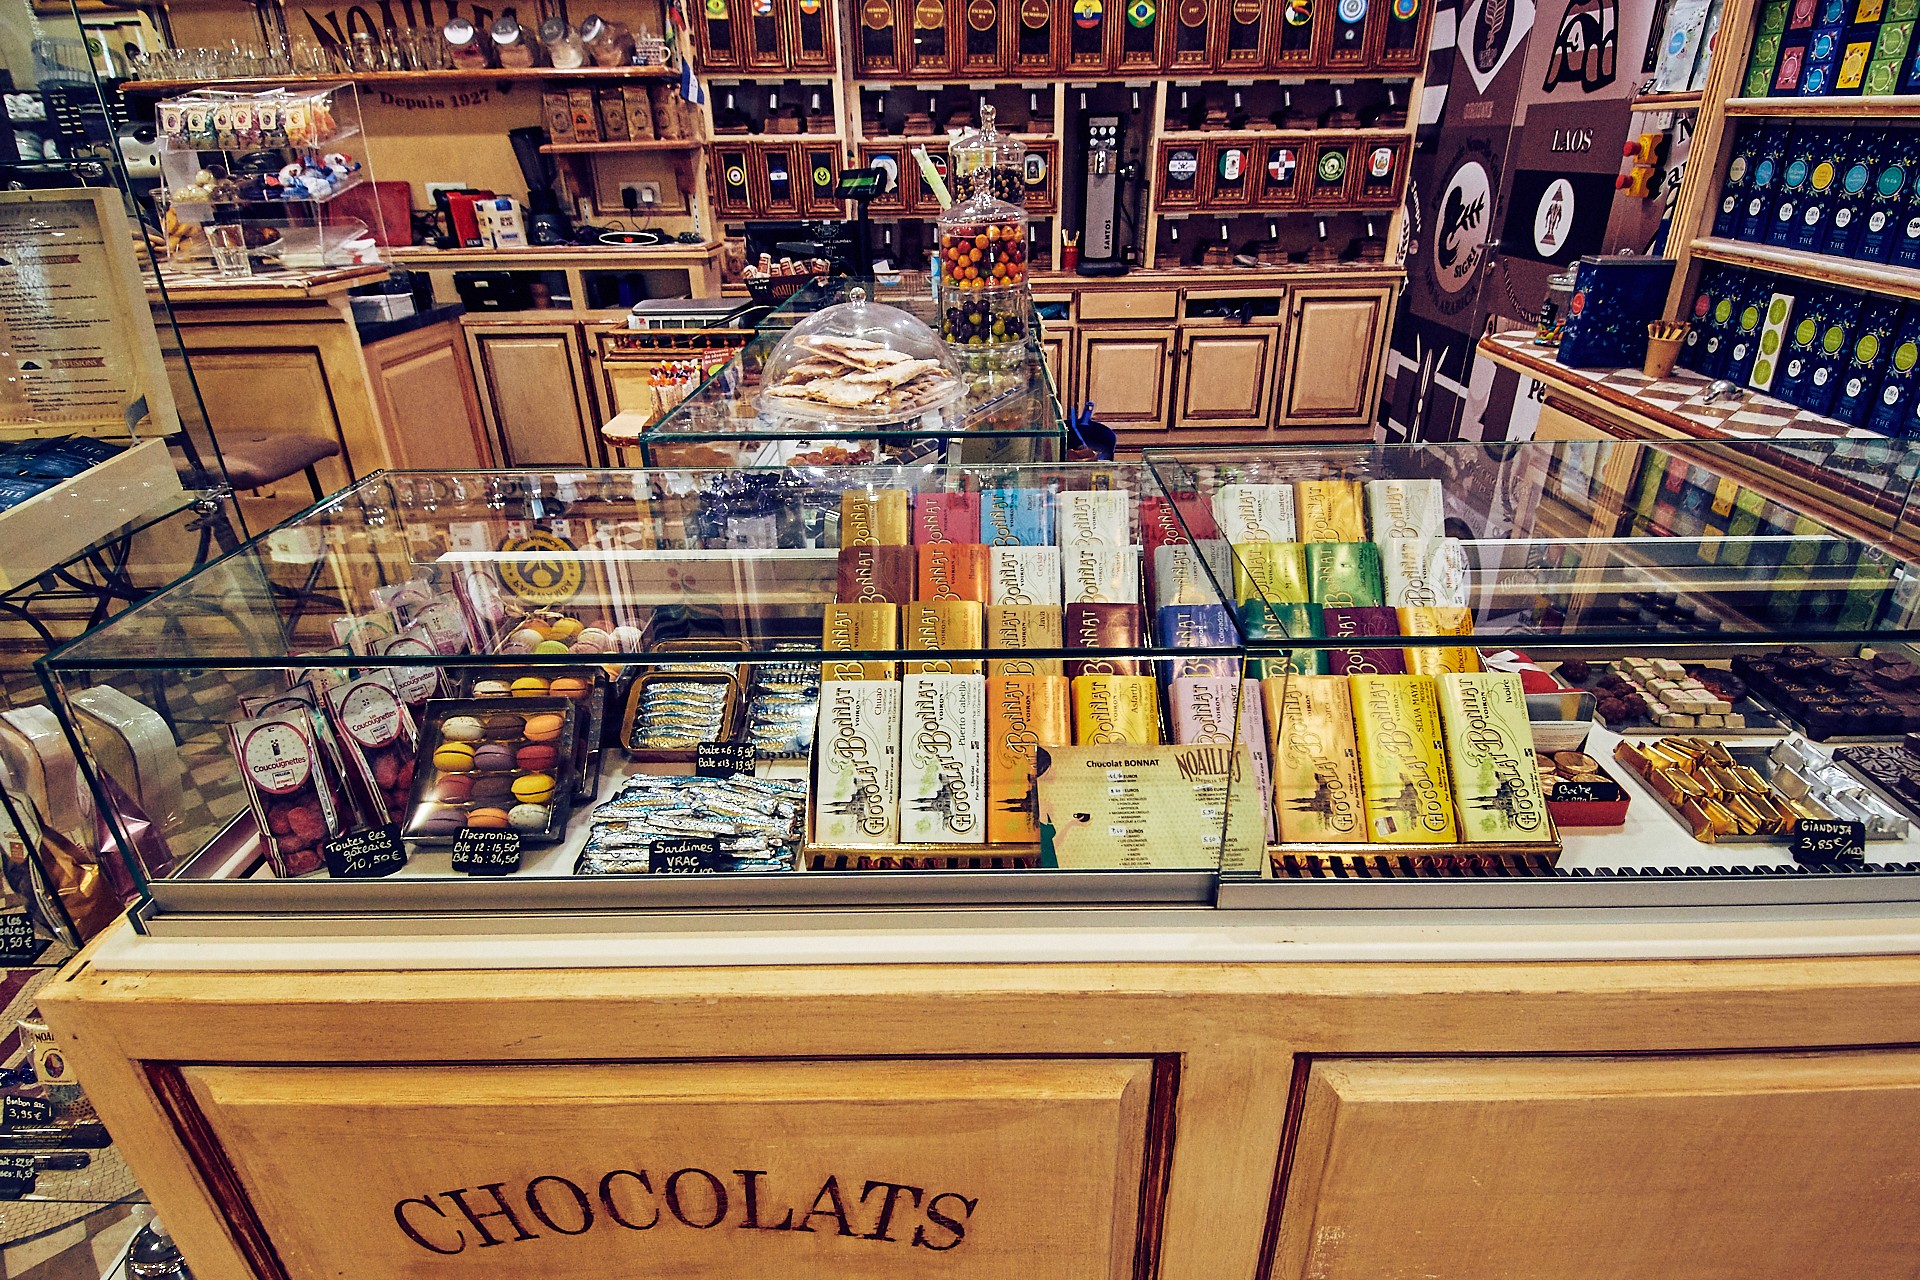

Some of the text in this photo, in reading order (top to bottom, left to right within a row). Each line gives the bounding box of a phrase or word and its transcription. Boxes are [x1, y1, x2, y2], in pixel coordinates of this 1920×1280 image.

[379, 89, 490, 110] Depuis 1927
[1550, 128, 1594, 153] LAOS
[1103, 219, 1112, 250] SANTOS
[1744, 227, 1755, 236] THÉ
[1773, 232, 1787, 241] THÉ
[1799, 236, 1813, 245] THÉ
[1830, 241, 1844, 250] THÉ
[1864, 246, 1879, 255] THÉ
[1900, 251, 1916, 260] THÉ
[57, 359, 98, 368] INFUSIONS
[0, 488, 26, 499] HÉ
[851, 496, 880, 546] BONNAT
[924, 498, 952, 546] BONNAT
[990, 494, 1021, 547] BONNAT
[1073, 496, 1104, 546] BONNAT
[1239, 488, 1271, 543] BONNAT
[1307, 486, 1340, 543] BONNAT
[1385, 485, 1419, 539] BONNAT
[855, 551, 887, 604] BONNAT
[929, 550, 961, 602] BONNAT
[999, 552, 1032, 605] BONNAT
[1078, 550, 1108, 604] BONNAT
[1400, 543, 1436, 608] BONNAT
[1038, 611, 1046, 629] Java
[874, 687, 883, 716] Chuao
[1130, 683, 1138, 713] Asfarth
[1481, 691, 1489, 719] VOIRON
[1503, 678, 1513, 703] Ivoire
[351, 710, 397, 733] Coucougnettes
[958, 681, 966, 746] Puerto Cabello
[1002, 680, 1039, 754] BONNAT
[1089, 681, 1127, 746] BONNAT
[1191, 684, 1231, 744] BONNAT
[1393, 694, 1401, 722] VOIRON
[1416, 707, 1424, 733] SELVA
[253, 756, 307, 774] Coucougnettes
[834, 687, 890, 838] CHOCOLAT BONNAT
[917, 680, 976, 835] CHOCOLAT BONNAT
[1086, 759, 1160, 768] Chocolat BONNAT
[1284, 683, 1359, 833] CHOCOLAT BONNAT
[1368, 680, 1449, 834] CHOCOLAT BONNAT
[1460, 679, 1541, 832] CHOCOLAT BONNAT
[325, 837, 365, 855] Toutes
[343, 850, 402, 874] 10,50€
[667, 857, 700, 867] VRAC
[9, 1108, 42, 1121] 3,95€
[393, 1167, 980, 1255] CHOCOLATS
